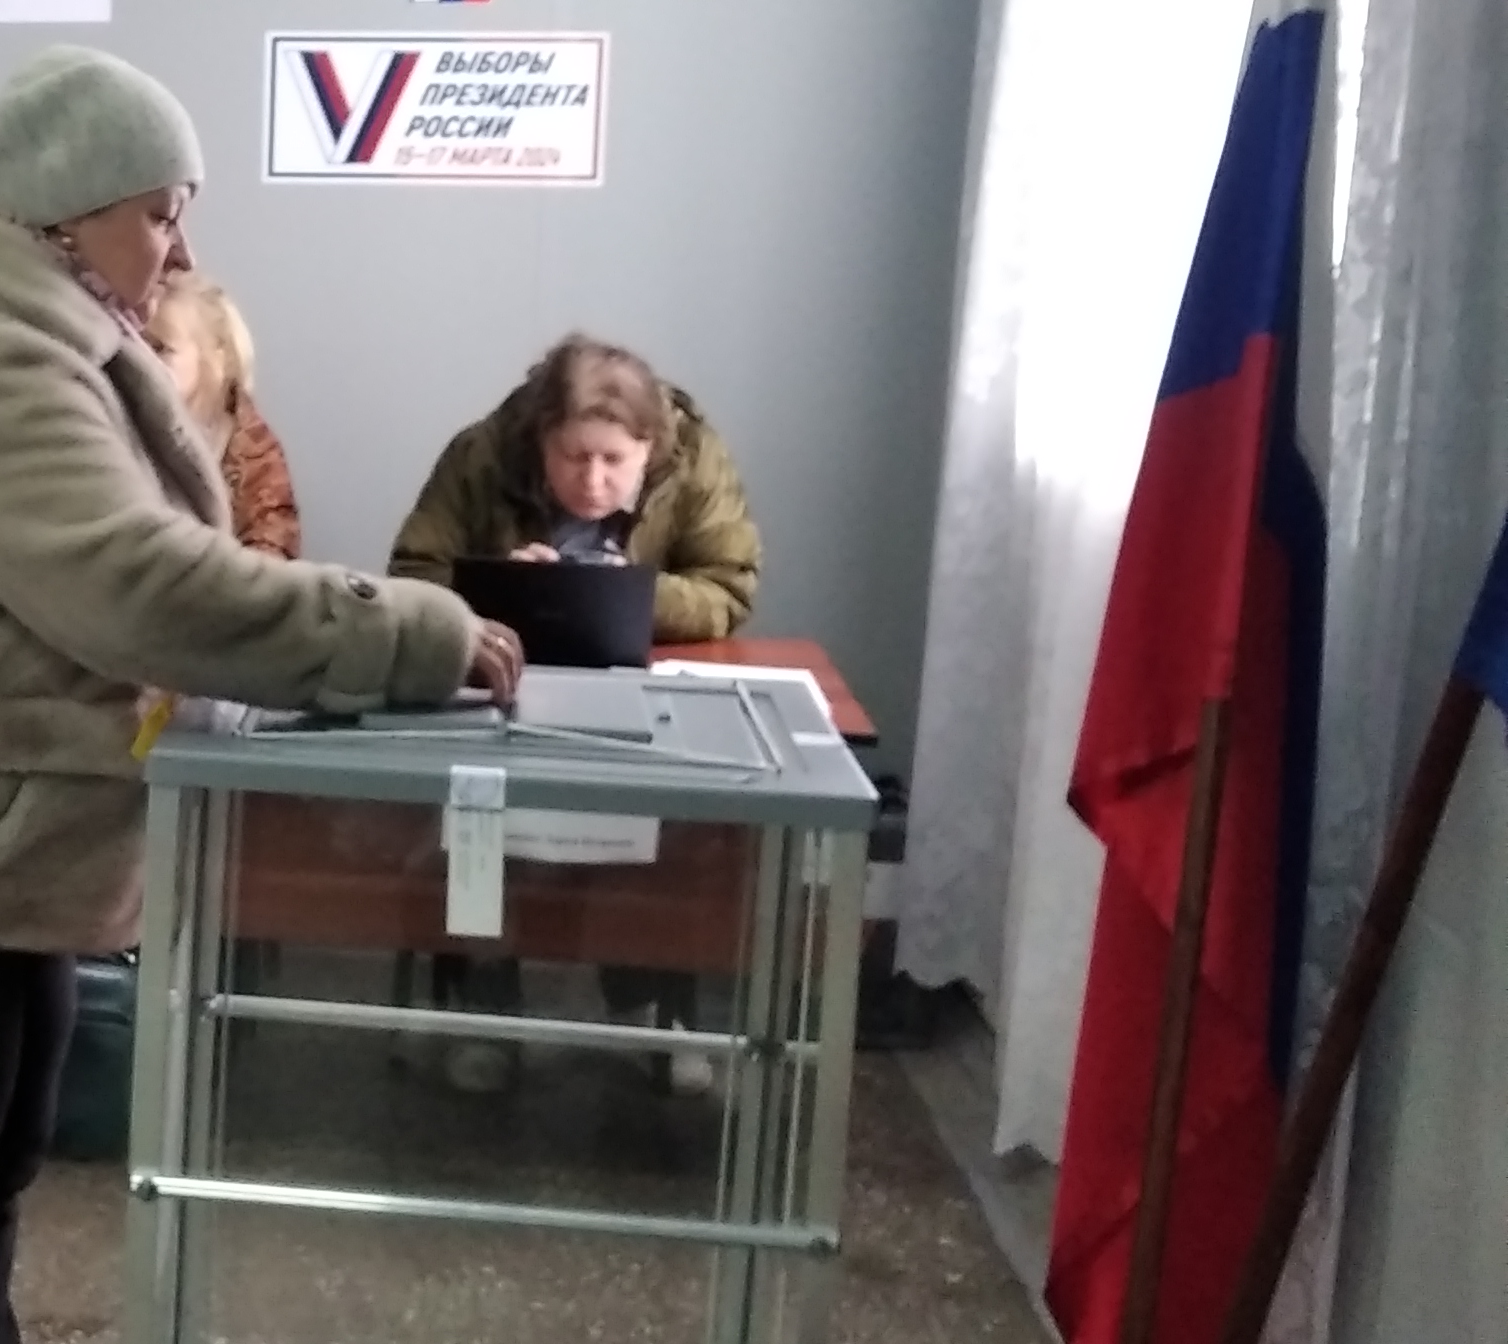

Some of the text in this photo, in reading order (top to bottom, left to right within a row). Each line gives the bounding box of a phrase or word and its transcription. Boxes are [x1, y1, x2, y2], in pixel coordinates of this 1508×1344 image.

[434, 51, 556, 74] ВЫБОРЫ
[419, 83, 590, 109] ПРЕЗИДЕНТА
[404, 115, 514, 138] РОССИИ
[448, 147, 514, 165] МАРТА
[516, 146, 562, 166] 2024
